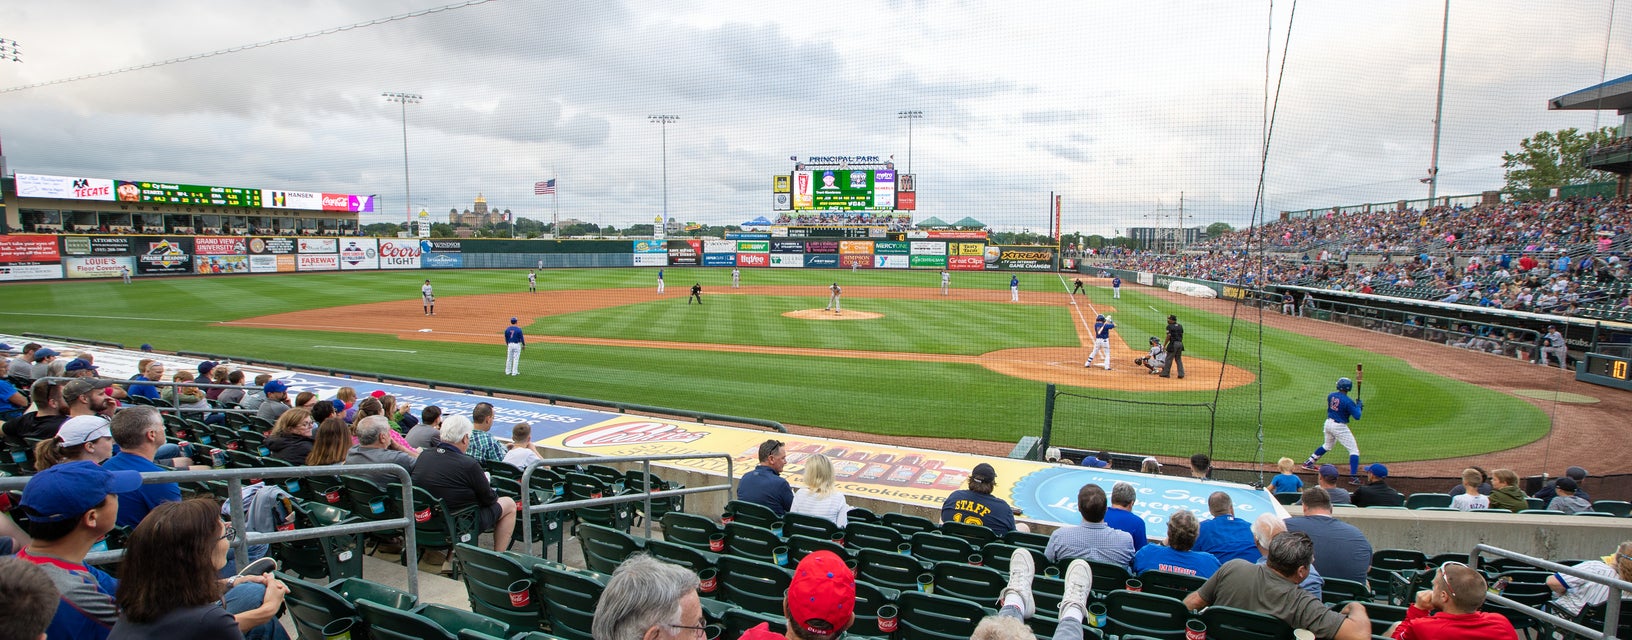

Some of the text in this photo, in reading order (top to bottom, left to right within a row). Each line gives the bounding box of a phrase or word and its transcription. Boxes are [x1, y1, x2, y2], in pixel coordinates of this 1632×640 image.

[877, 173, 893, 181] metro
[75, 187, 109, 198] TECATE
[380, 242, 421, 257] Coors
[1002, 251, 1051, 260] XTREAM
[967, 257, 984, 265] Clips
[510, 330, 516, 339] 7
[954, 500, 991, 517] STAFF
